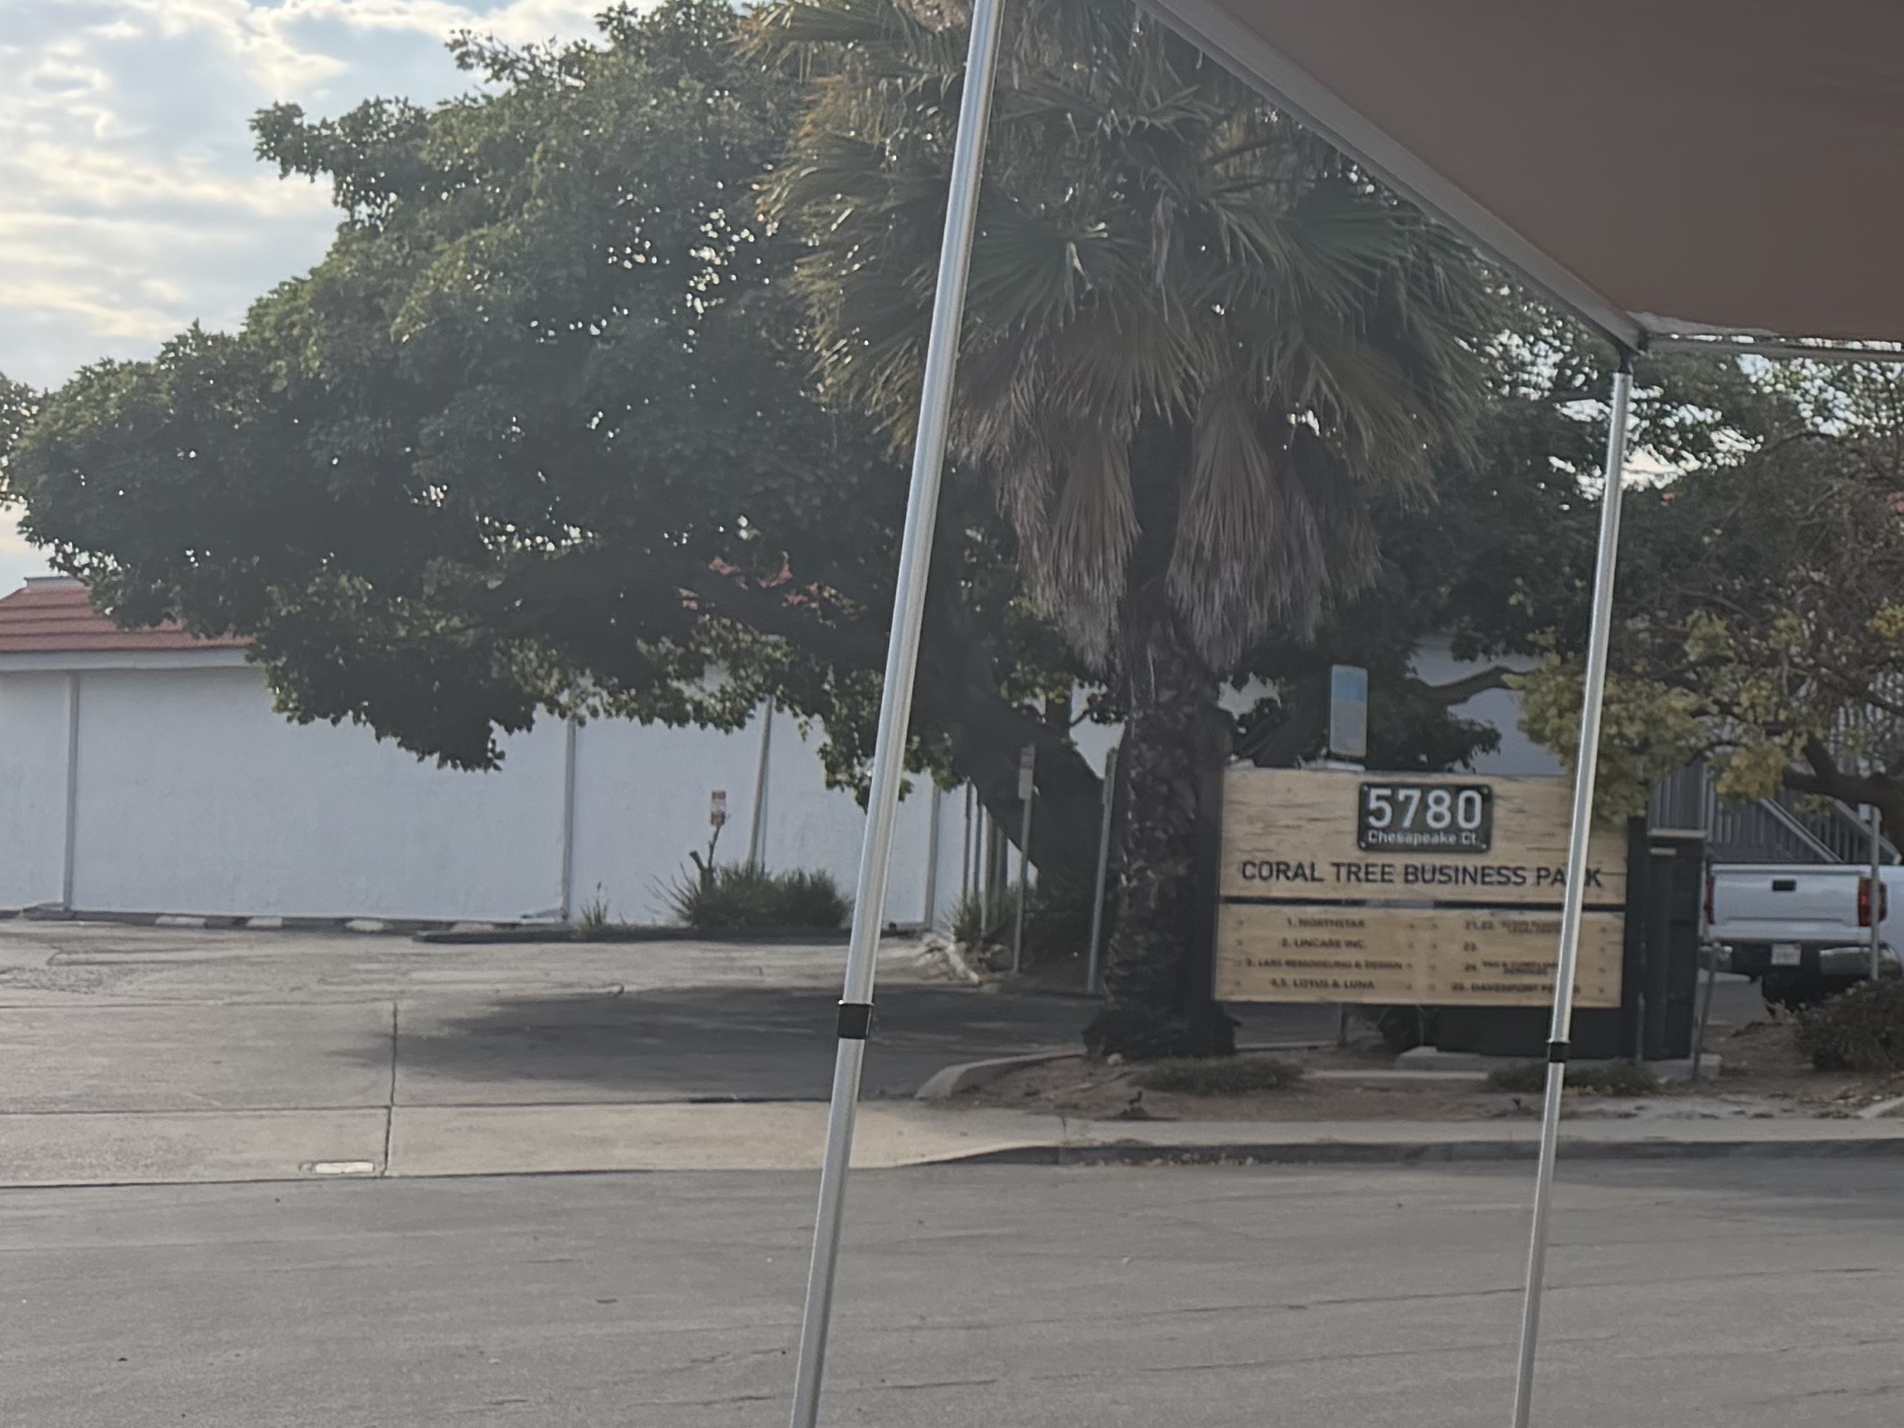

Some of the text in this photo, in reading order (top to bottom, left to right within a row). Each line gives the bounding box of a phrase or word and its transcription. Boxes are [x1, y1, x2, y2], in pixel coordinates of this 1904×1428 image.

[1368, 787, 1482, 829] 5780
[1368, 830, 1457, 845] Chesapeake
[1241, 860, 1603, 888] CORAL TREE BUSINESS PAK
